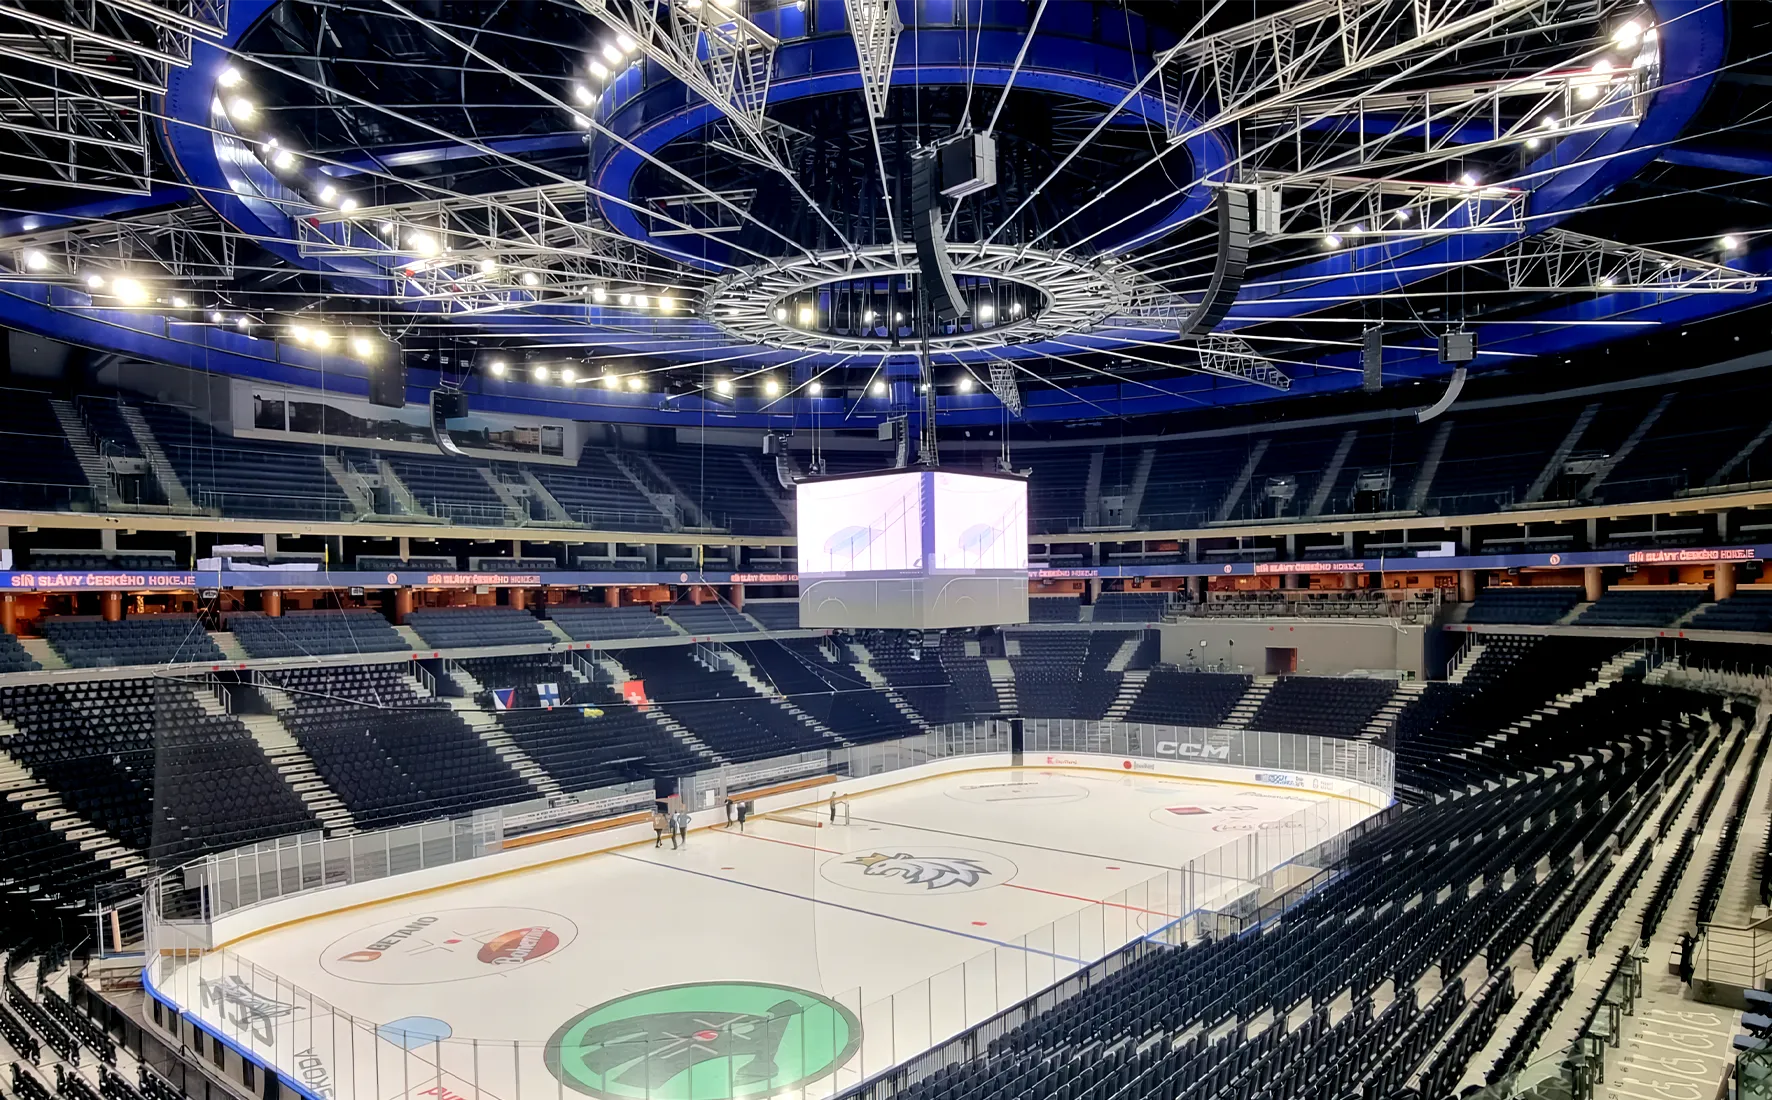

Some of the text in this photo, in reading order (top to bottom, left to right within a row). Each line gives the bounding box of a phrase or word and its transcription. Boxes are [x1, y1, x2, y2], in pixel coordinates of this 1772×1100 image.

[38, 574, 82, 587] SLÁVY
[86, 573, 145, 586] ČESKÉHO
[149, 575, 196, 586] HOKEJE
[1157, 741, 1230, 759] CCM
[366, 916, 439, 951] BETANO
